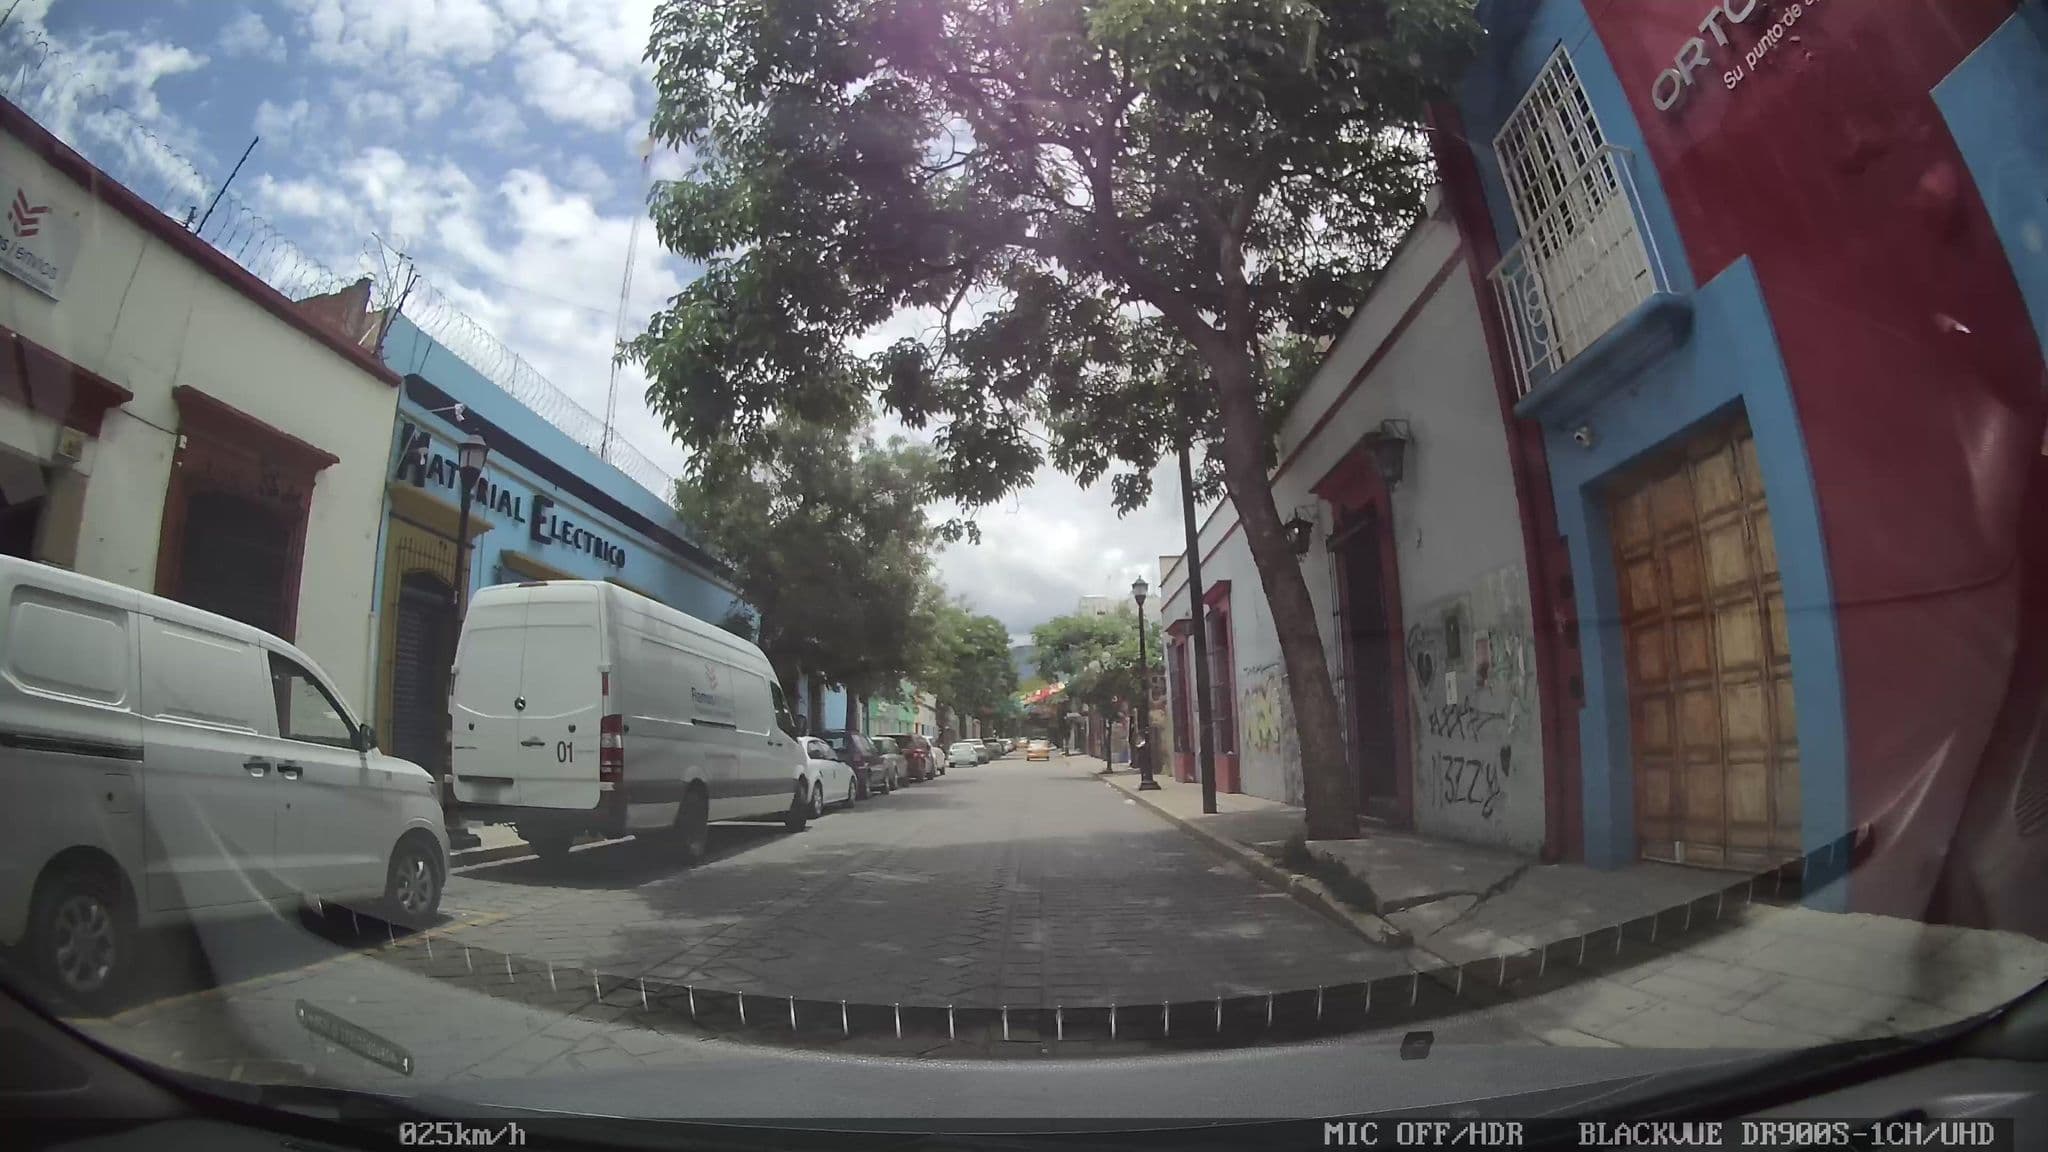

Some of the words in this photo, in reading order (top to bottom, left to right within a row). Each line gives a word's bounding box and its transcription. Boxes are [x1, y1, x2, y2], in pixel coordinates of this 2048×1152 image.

[1723, 65, 1745, 90] Su
[1745, 23, 1784, 71] punto
[1783, 3, 1802, 27] de
[397, 422, 526, 524] MATRIAL
[530, 494, 626, 569] ELECTRICO
[556, 740, 574, 764] 01
